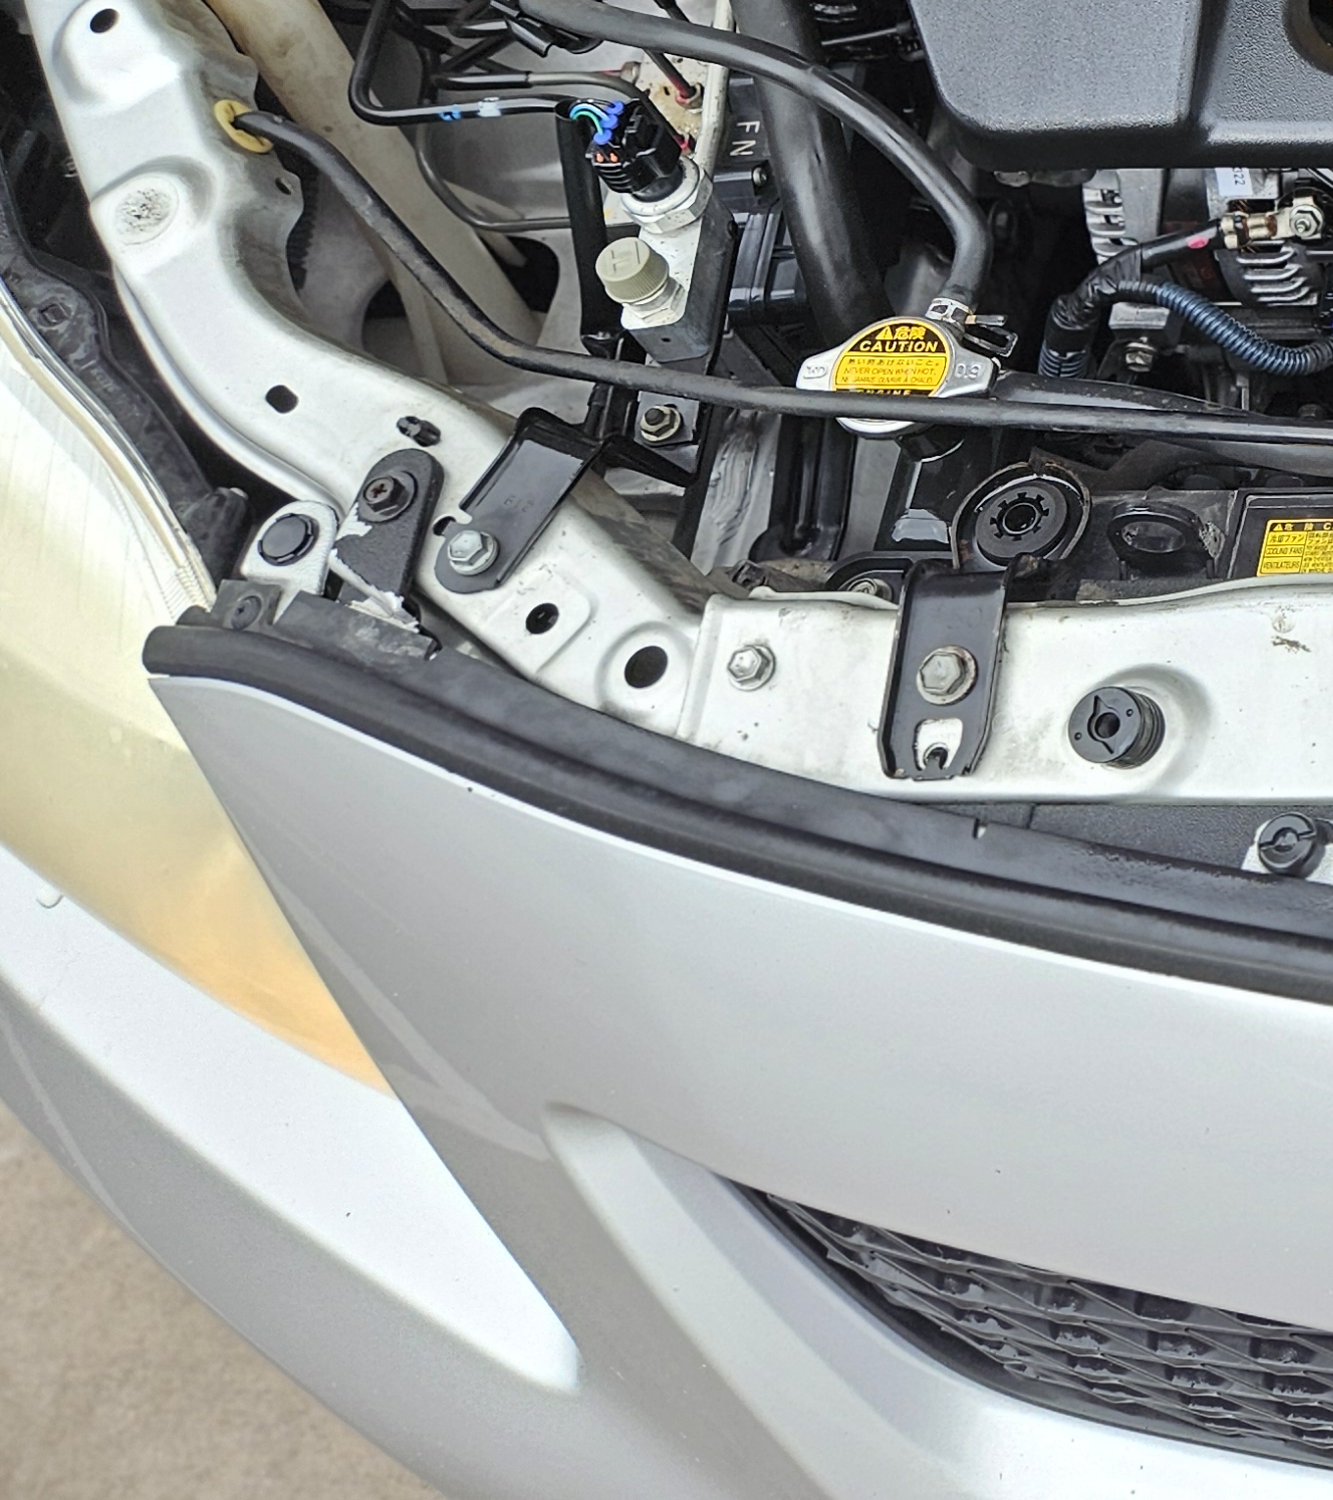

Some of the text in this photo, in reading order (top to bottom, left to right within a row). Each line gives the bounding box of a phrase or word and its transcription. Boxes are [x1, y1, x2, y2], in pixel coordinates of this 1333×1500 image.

[859, 340, 939, 352] CAUTION
[843, 367, 871, 375] NEVER
[871, 367, 893, 375] OPEN
[894, 367, 917, 375] WHEN
[1289, 546, 1303, 554] FANS
